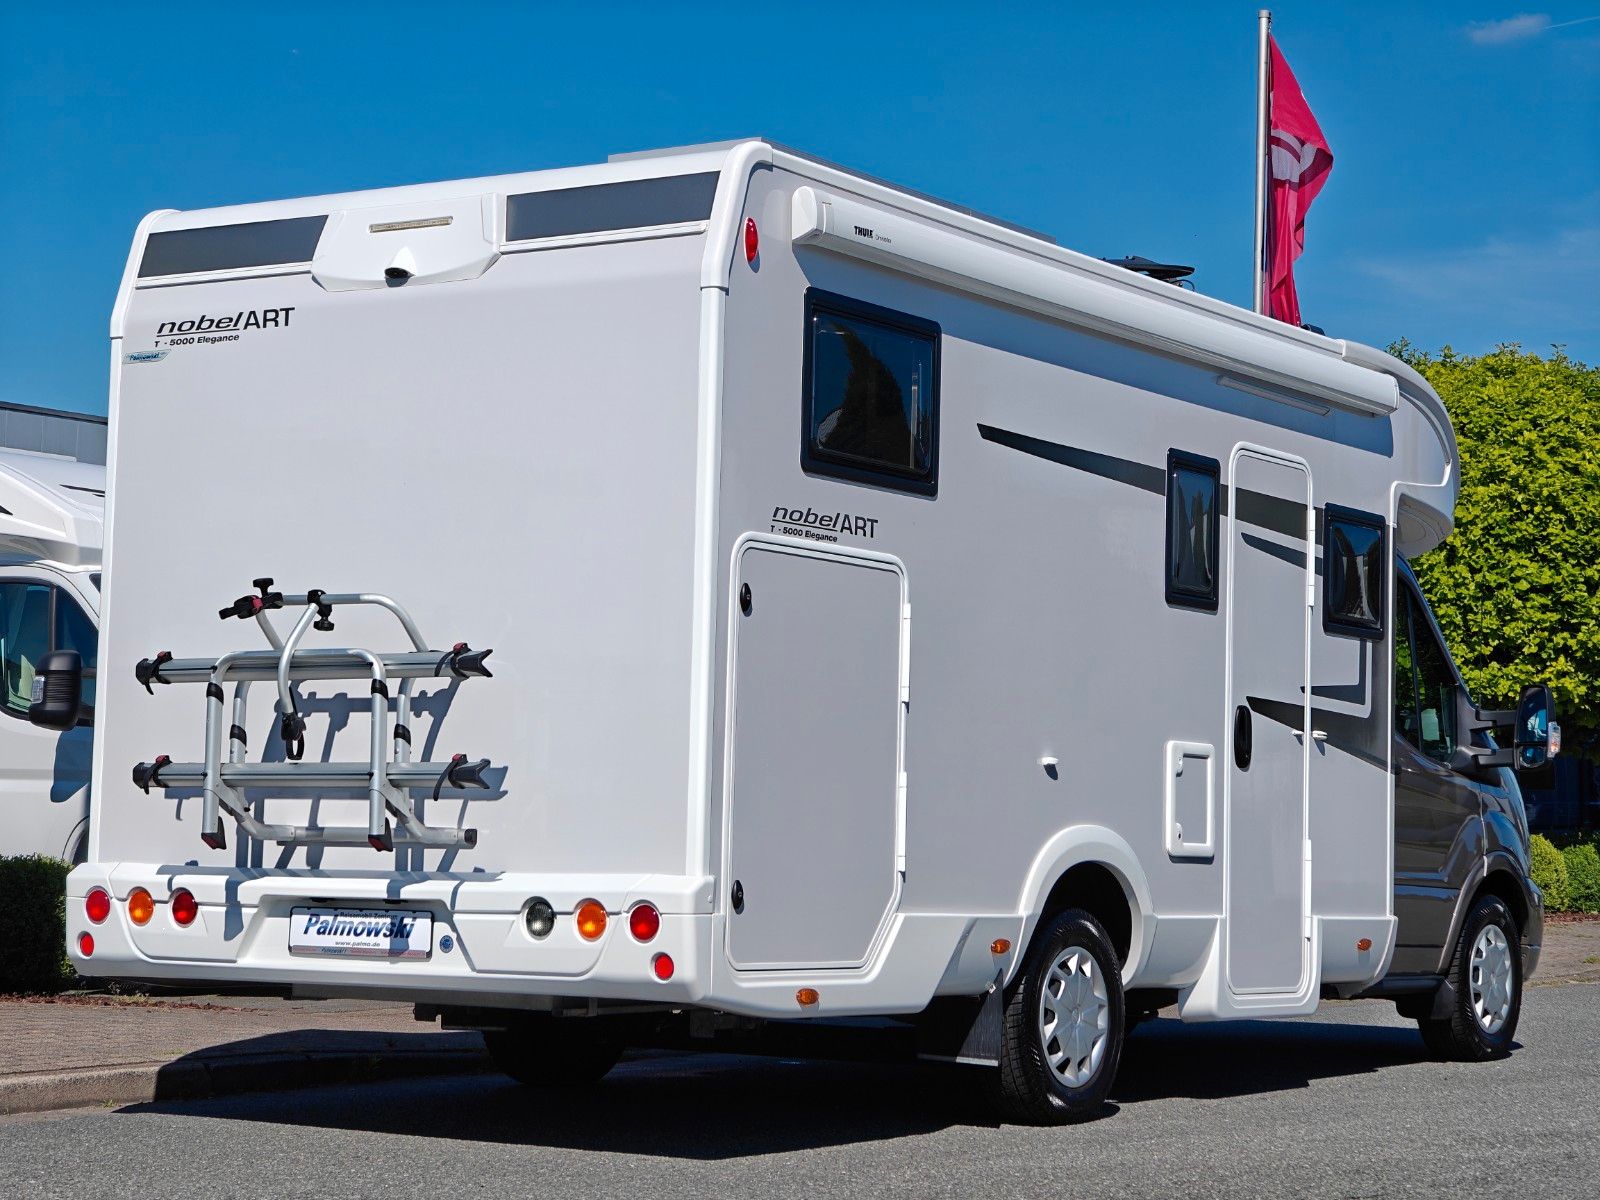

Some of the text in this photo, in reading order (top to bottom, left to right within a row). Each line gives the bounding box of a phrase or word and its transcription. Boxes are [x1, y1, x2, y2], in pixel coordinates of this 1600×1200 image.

[853, 225, 874, 239] THULE
[169, 337, 195, 347] 5000
[197, 334, 240, 345] Elegance
[770, 525, 776, 533] T
[783, 526, 803, 536] 5000
[804, 530, 838, 542] Elegance
[303, 913, 417, 939] Palmowski
